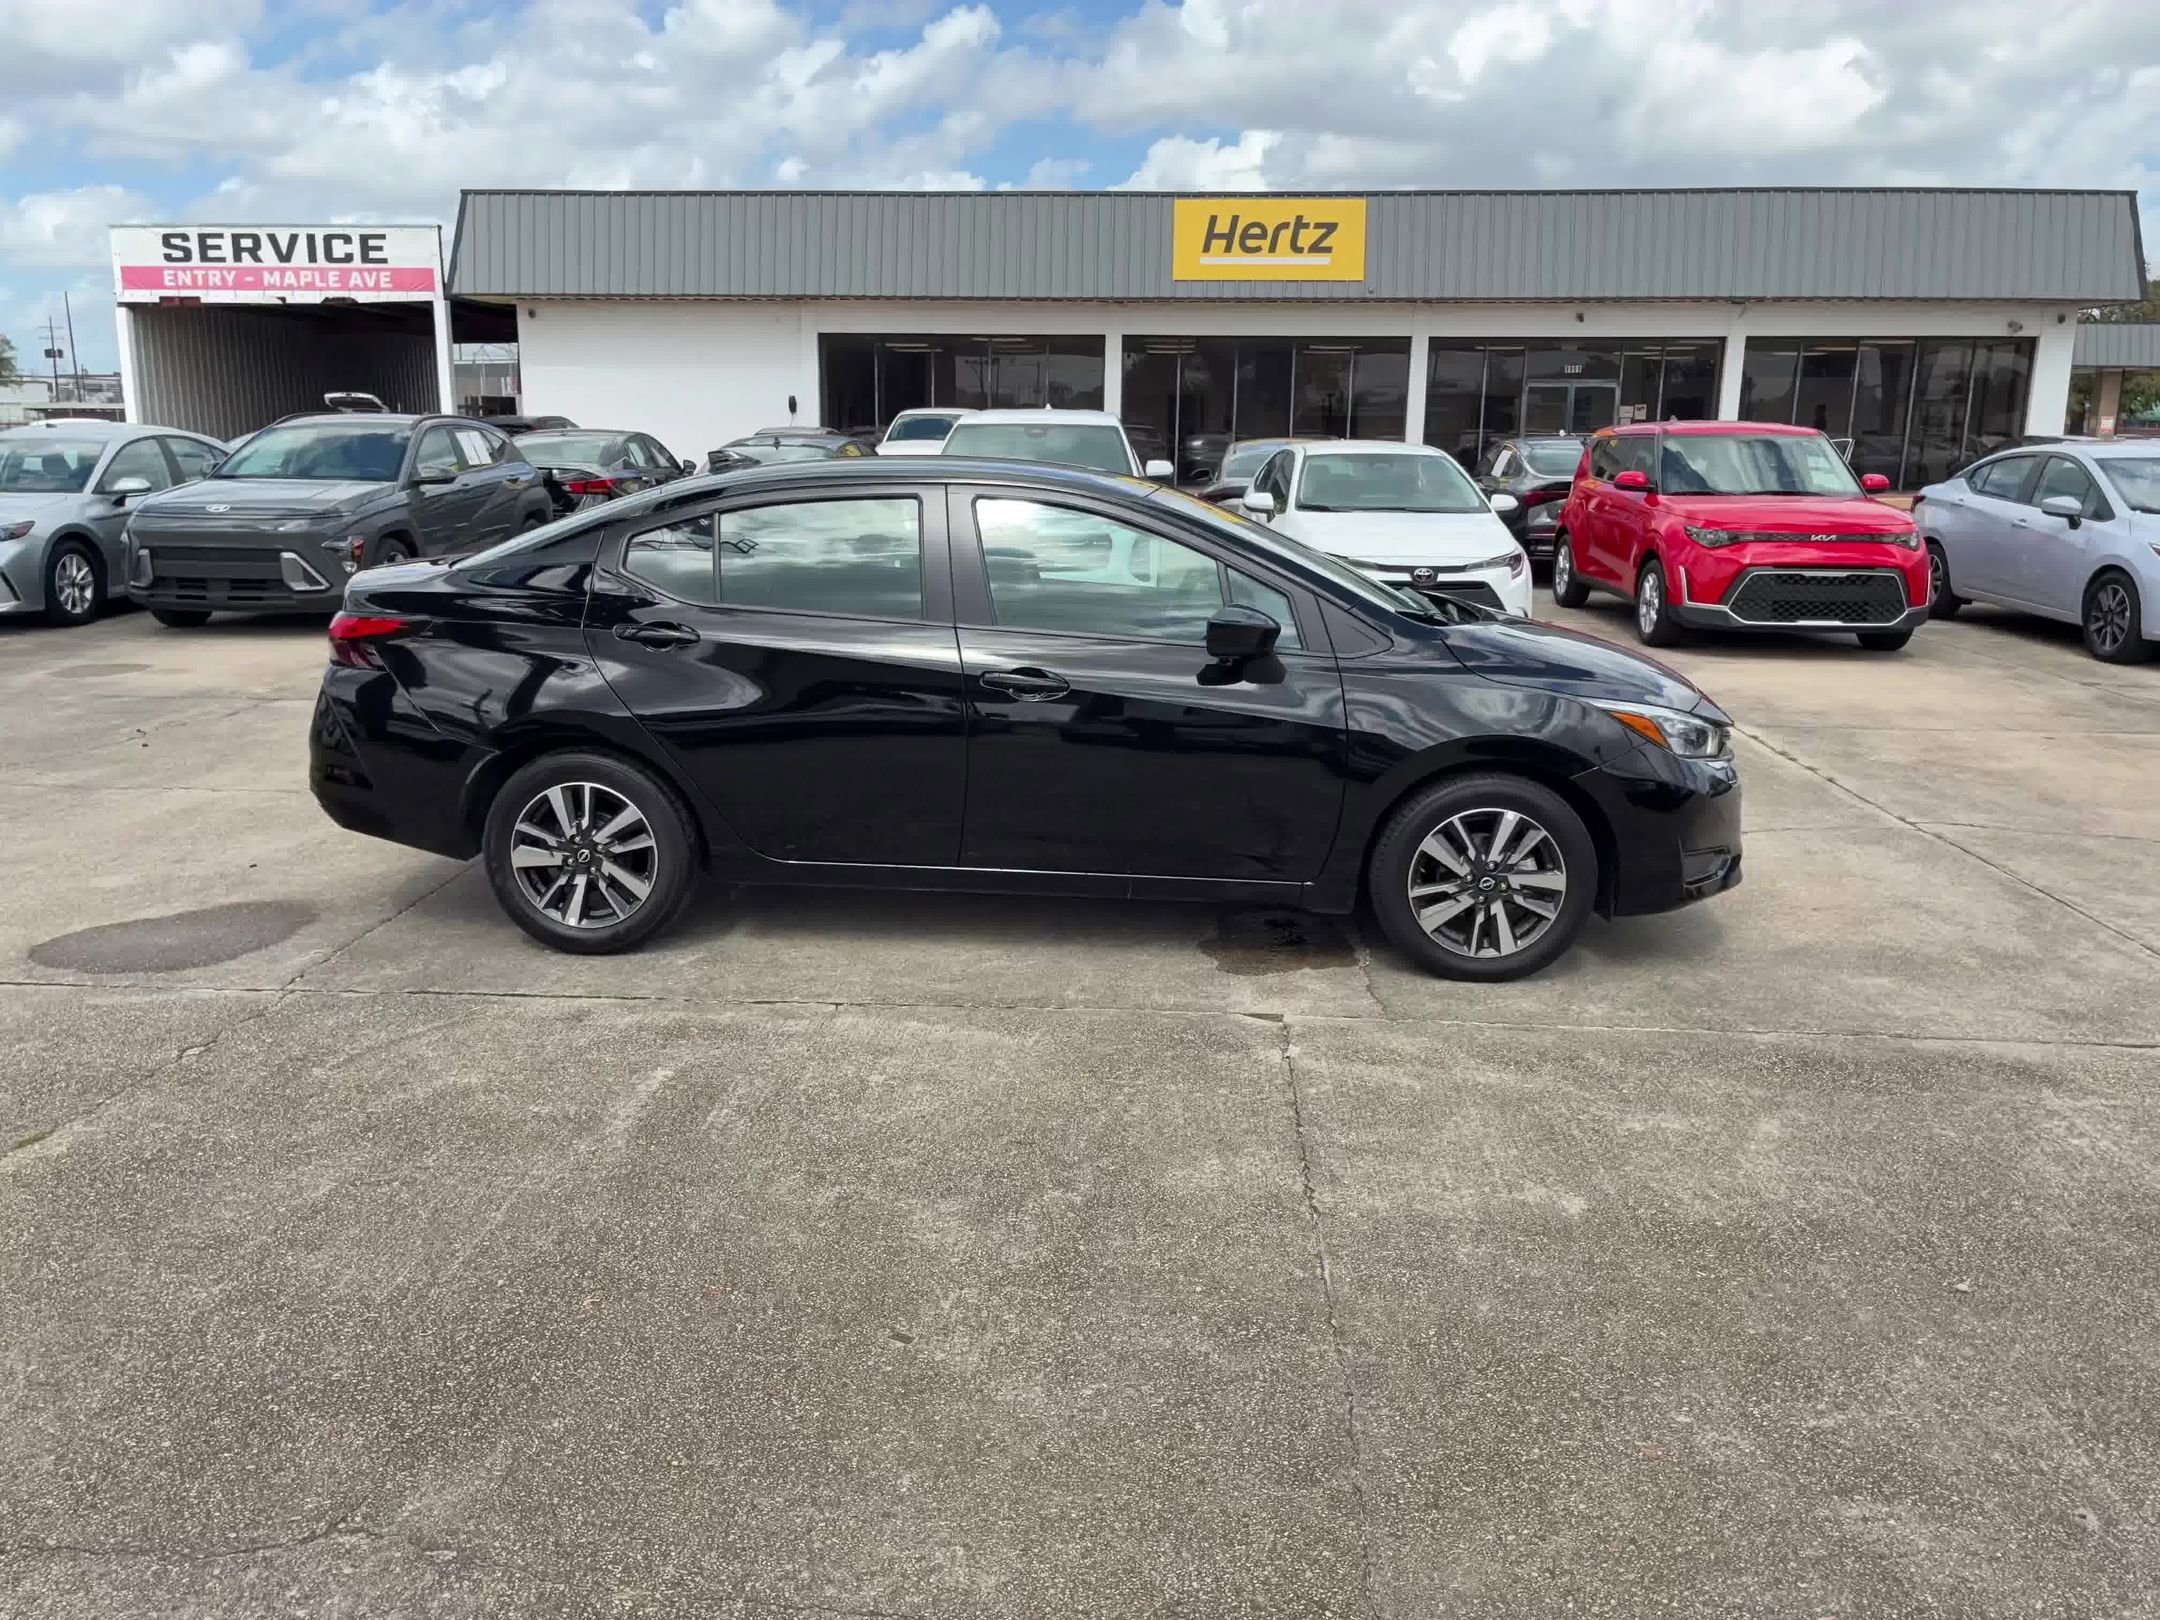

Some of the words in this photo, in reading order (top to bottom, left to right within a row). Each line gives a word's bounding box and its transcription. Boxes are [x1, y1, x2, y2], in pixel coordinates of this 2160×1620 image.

[161, 232, 388, 264] SERVICE
[1202, 215, 1339, 254] Hertz
[163, 269, 236, 286] ENTRY
[263, 270, 340, 287] MAPLE
[349, 271, 392, 288] AVE
